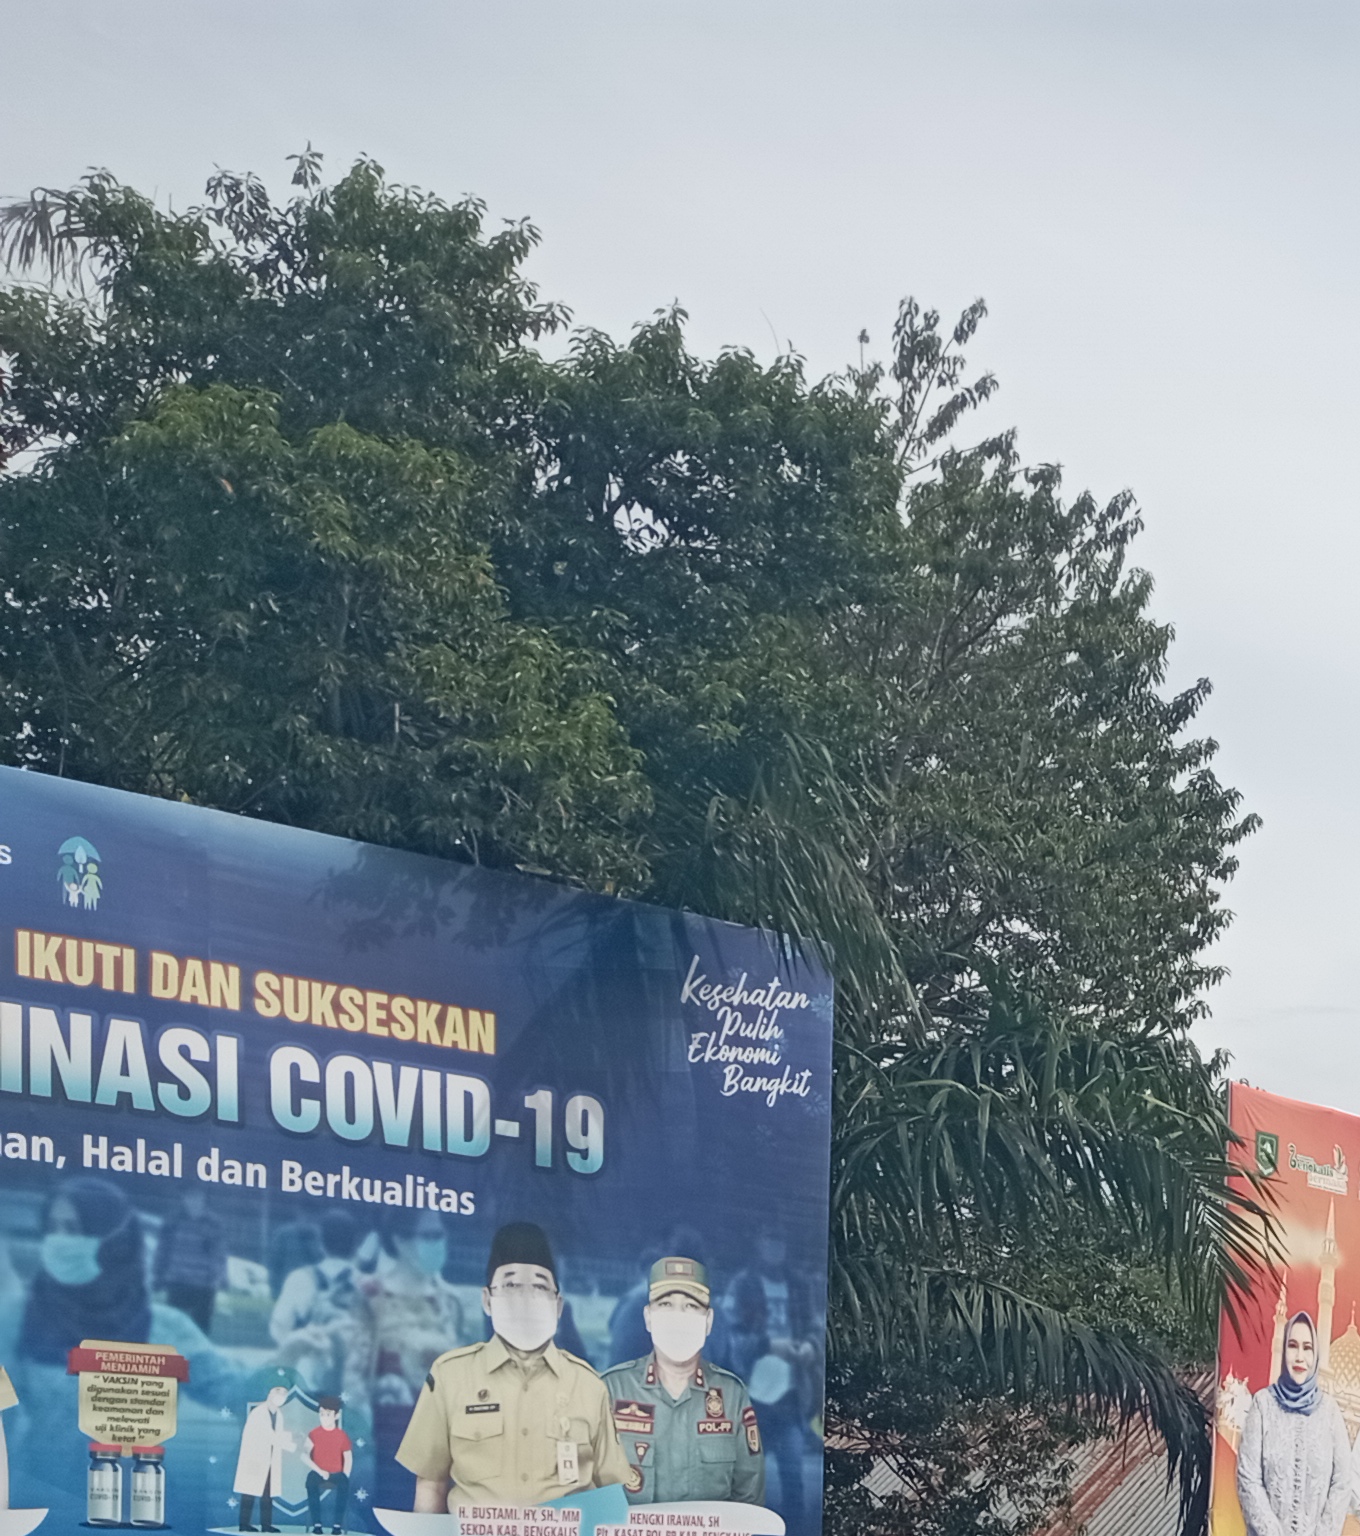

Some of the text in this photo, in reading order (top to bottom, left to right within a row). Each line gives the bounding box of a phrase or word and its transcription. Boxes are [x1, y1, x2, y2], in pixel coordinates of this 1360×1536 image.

[16, 929, 496, 1056] IKUTI DAN SUKSESKAN
[681, 954, 810, 1010] Kesehatan
[716, 1007, 784, 1046] Pulih
[687, 1031, 781, 1065] Ekonomi
[720, 1064, 812, 1108] Bangkit
[269, 1046, 605, 1174] COVID-19
[0, 1131, 476, 1216] an, Halal dan Berkualitas
[95, 1352, 166, 1365] PEMERINTAH
[100, 1362, 160, 1375] MENJAMIN
[102, 1375, 164, 1389] VAKSIN yang
[459, 1507, 469, 1519] H.
[562, 1510, 580, 1522] MM
[460, 1523, 494, 1536] SEKDA
[497, 1525, 521, 1536] KAB.
[630, 1513, 664, 1526] HENGKI
[708, 1516, 720, 1527] SH
